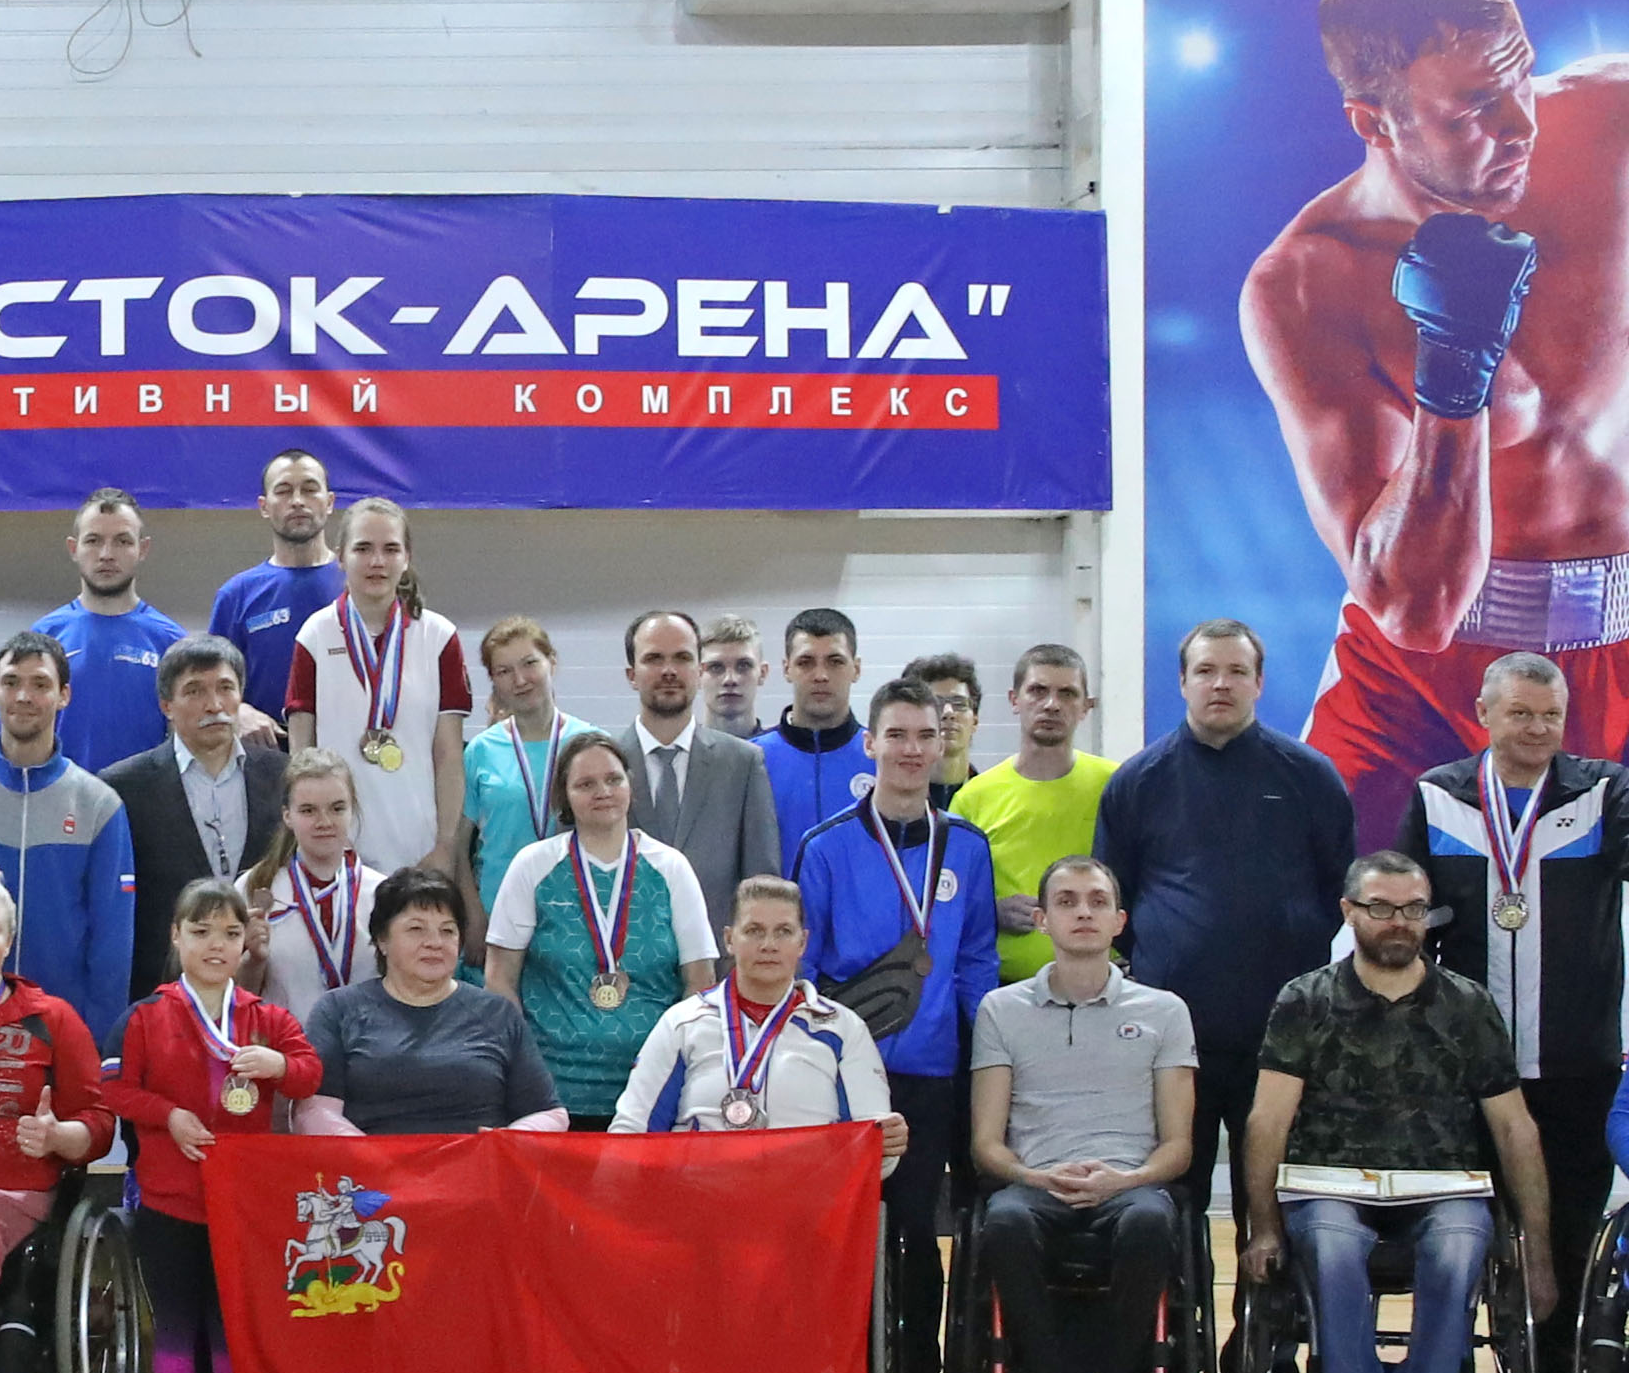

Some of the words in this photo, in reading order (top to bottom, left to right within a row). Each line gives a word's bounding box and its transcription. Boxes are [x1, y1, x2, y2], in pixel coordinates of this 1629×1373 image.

[514, 382, 970, 418] КОМПЛЕКС
[272, 607, 291, 625] 63
[141, 651, 160, 668] 63
